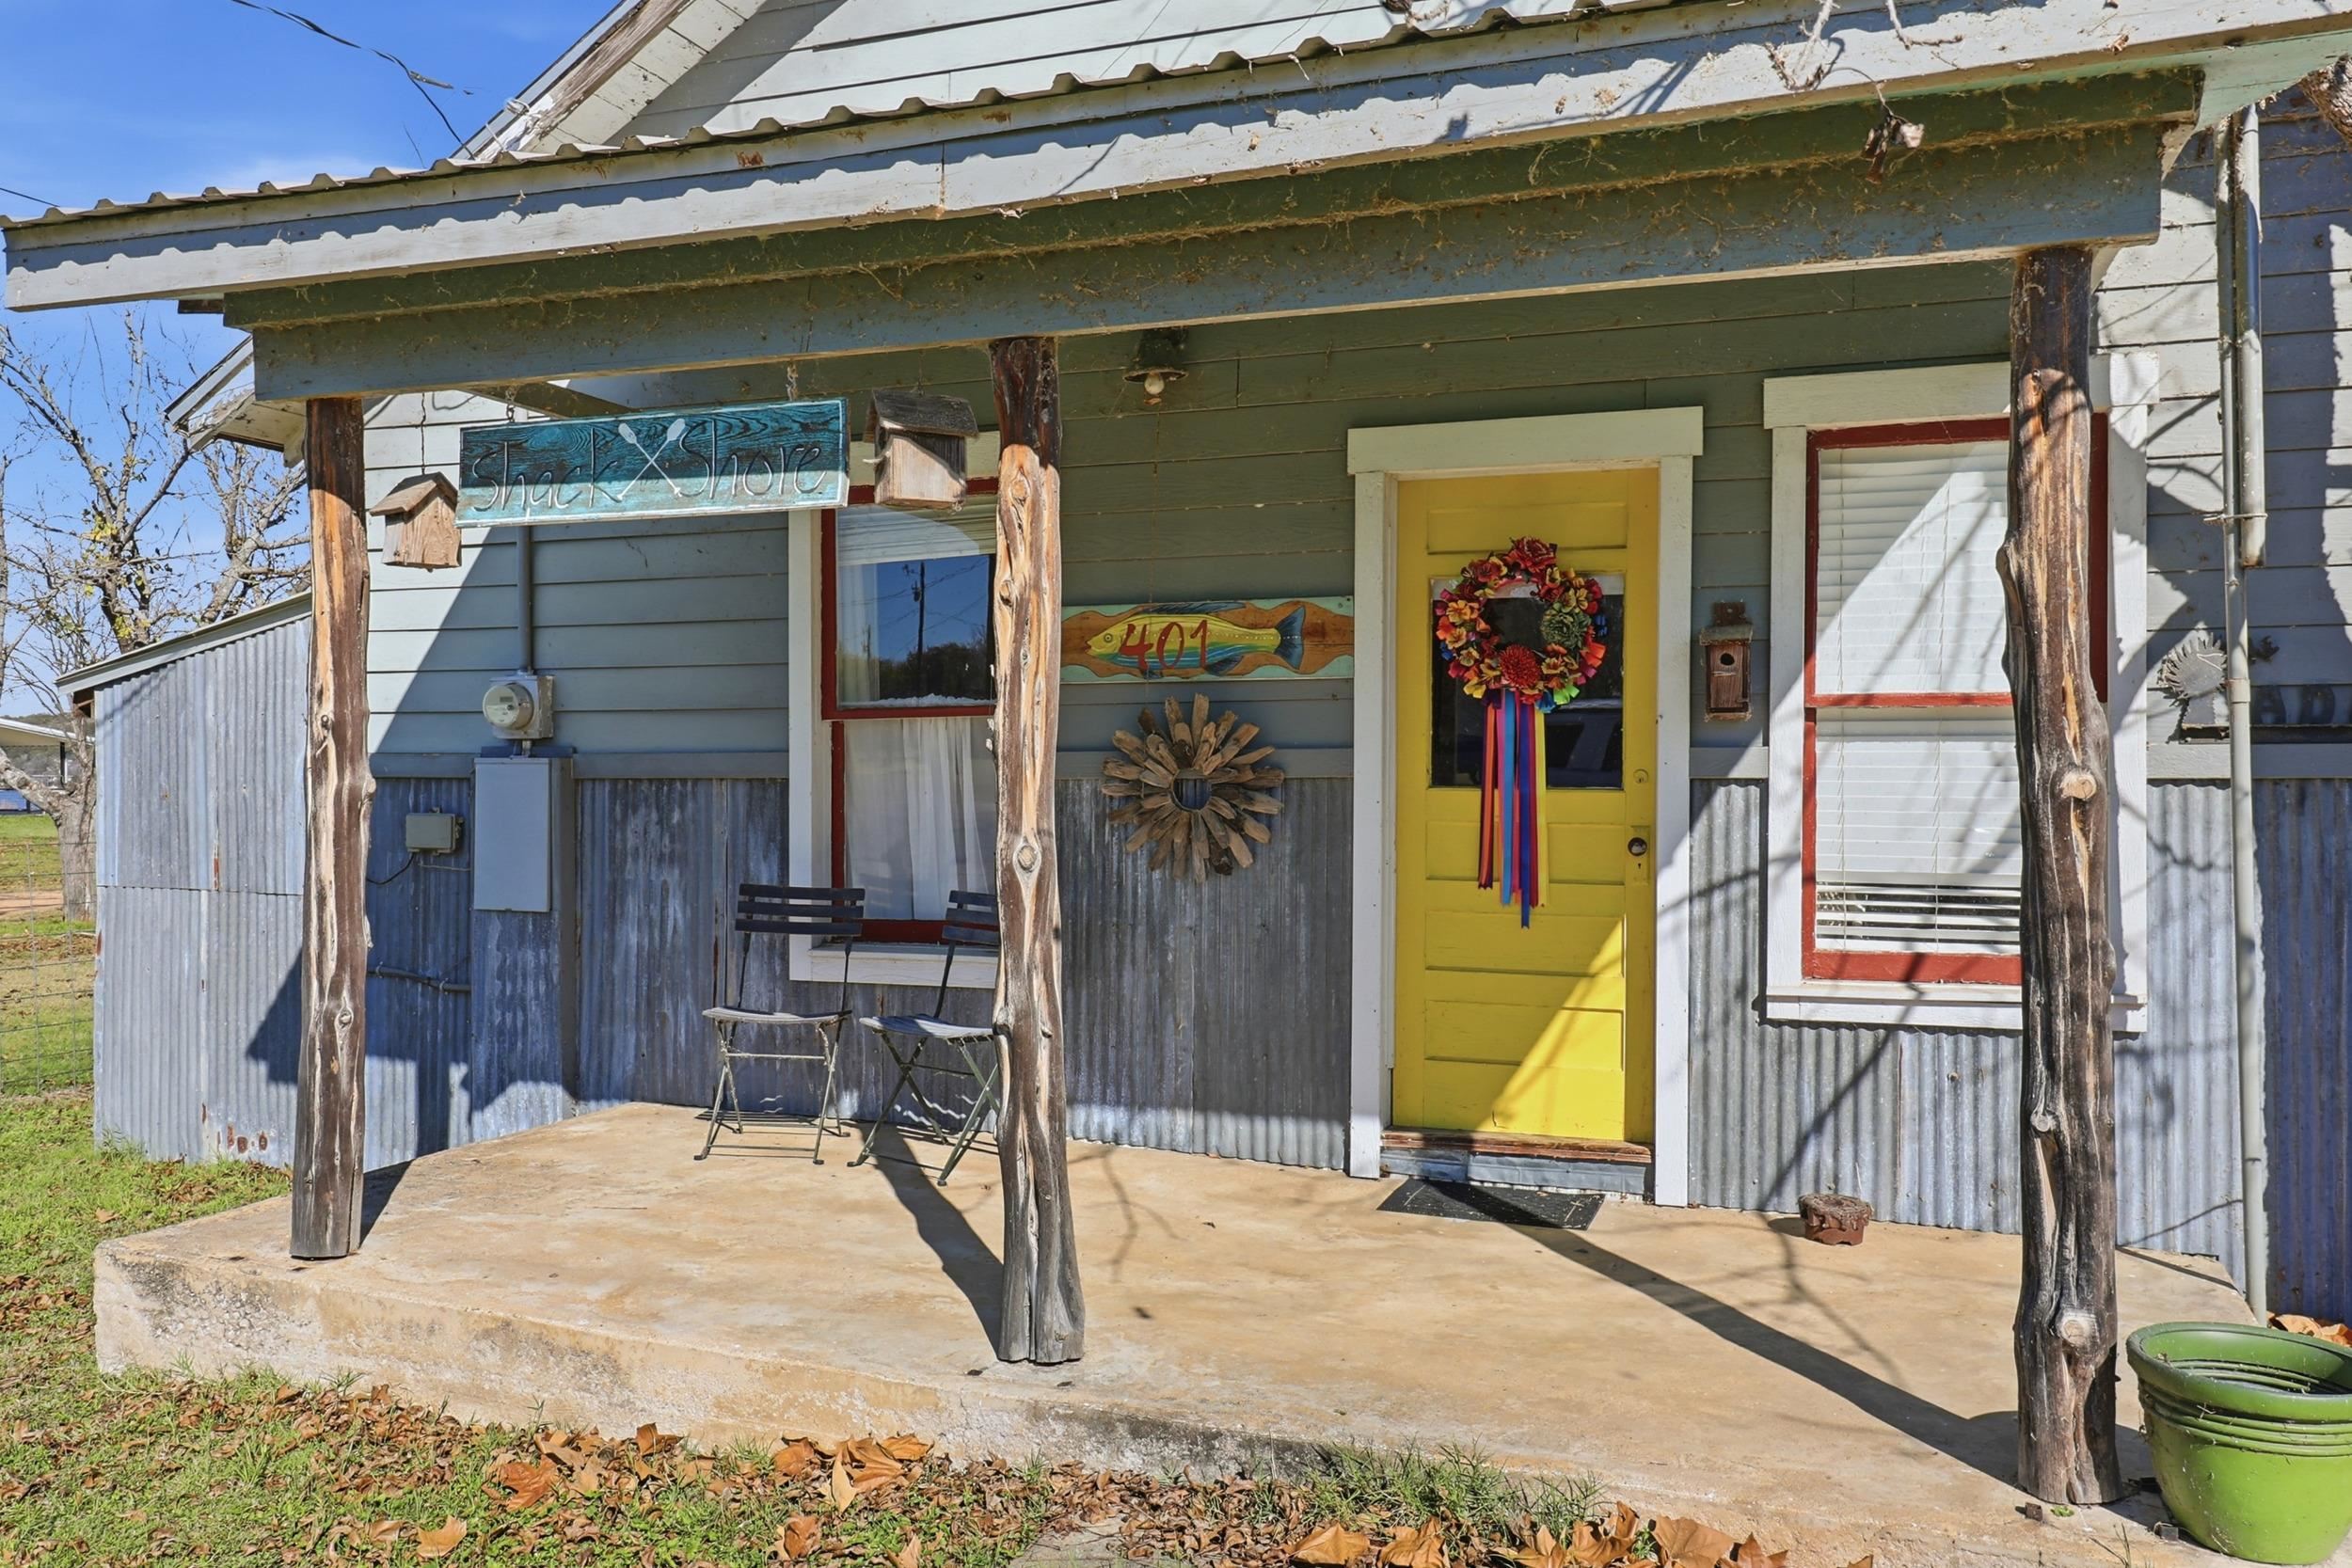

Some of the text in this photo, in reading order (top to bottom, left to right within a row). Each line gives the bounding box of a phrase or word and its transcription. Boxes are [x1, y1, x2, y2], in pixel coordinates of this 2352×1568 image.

[472, 418, 827, 513] Shack Shore
[1118, 619, 1209, 670] 401
